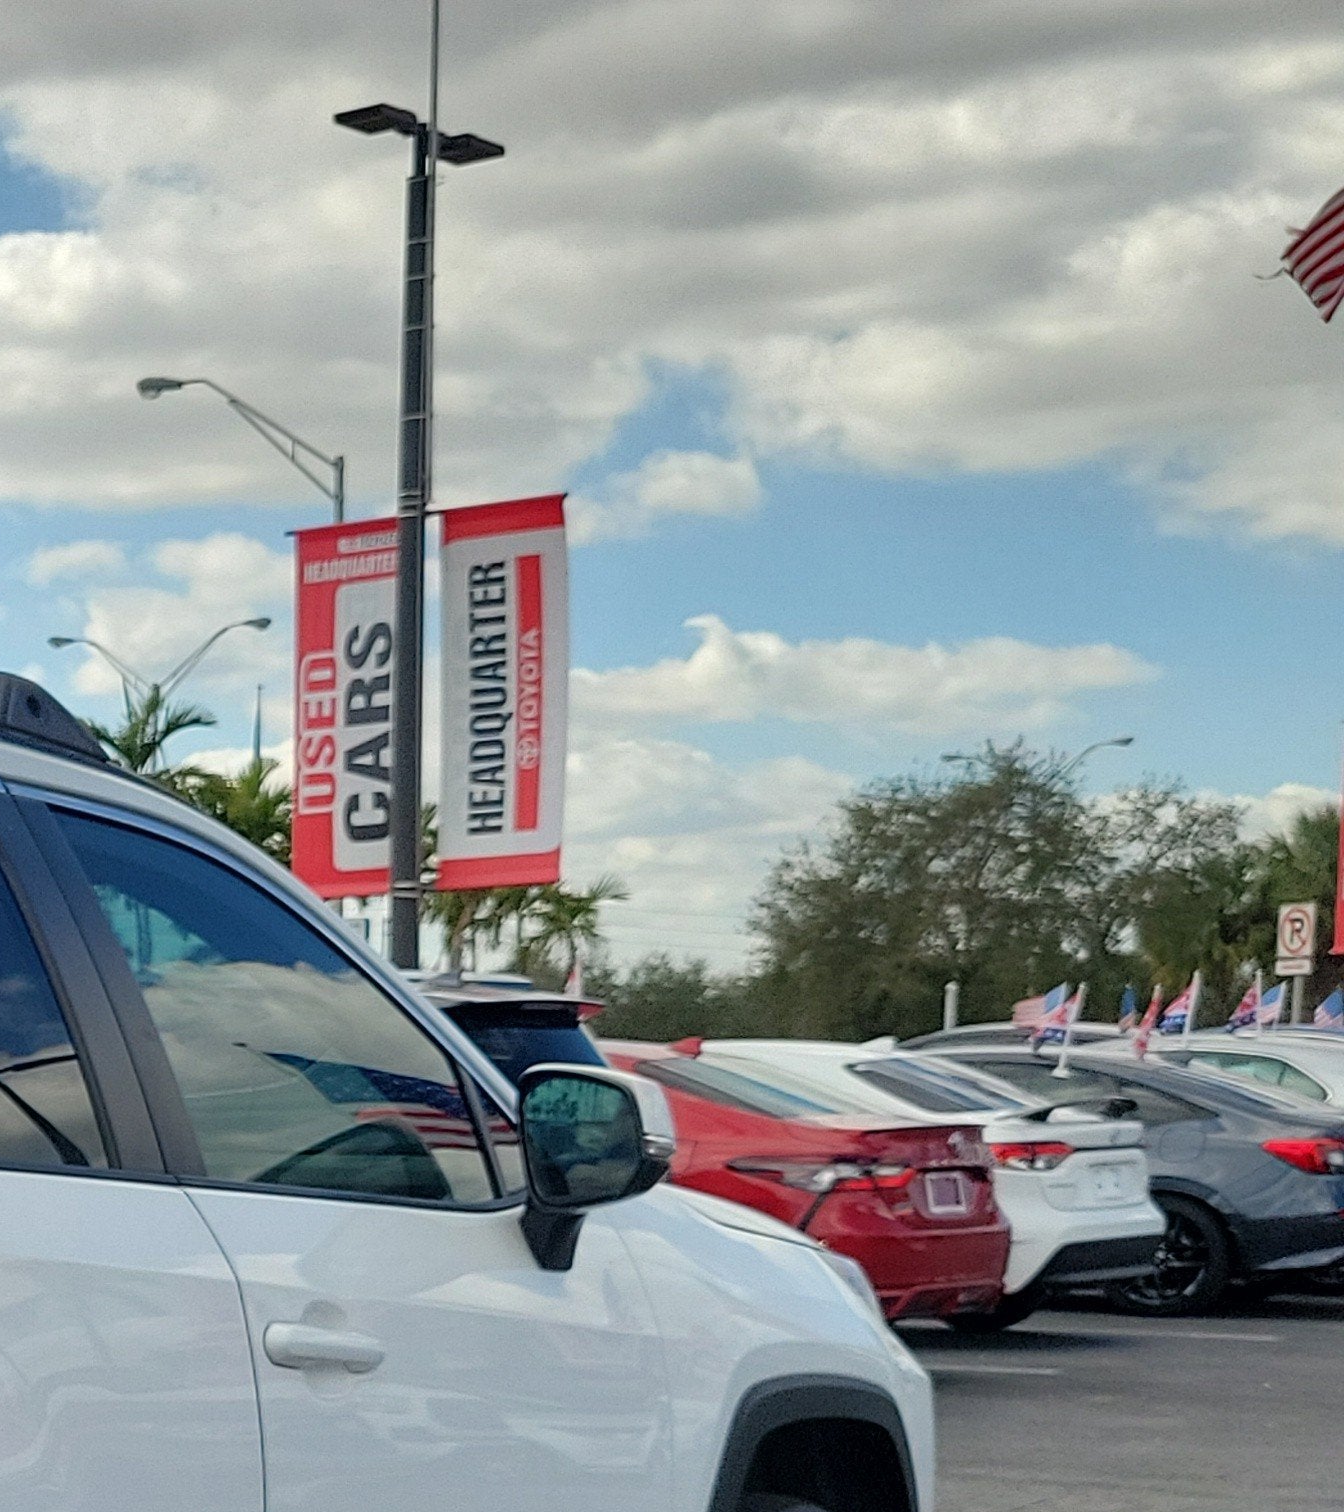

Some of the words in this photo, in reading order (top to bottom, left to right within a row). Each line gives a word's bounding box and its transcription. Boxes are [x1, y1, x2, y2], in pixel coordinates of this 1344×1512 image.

[299, 653, 337, 814] USED
[343, 622, 393, 842] CARS
[467, 560, 513, 835] HEADQUARTER
[519, 627, 541, 735] TOYOTA
